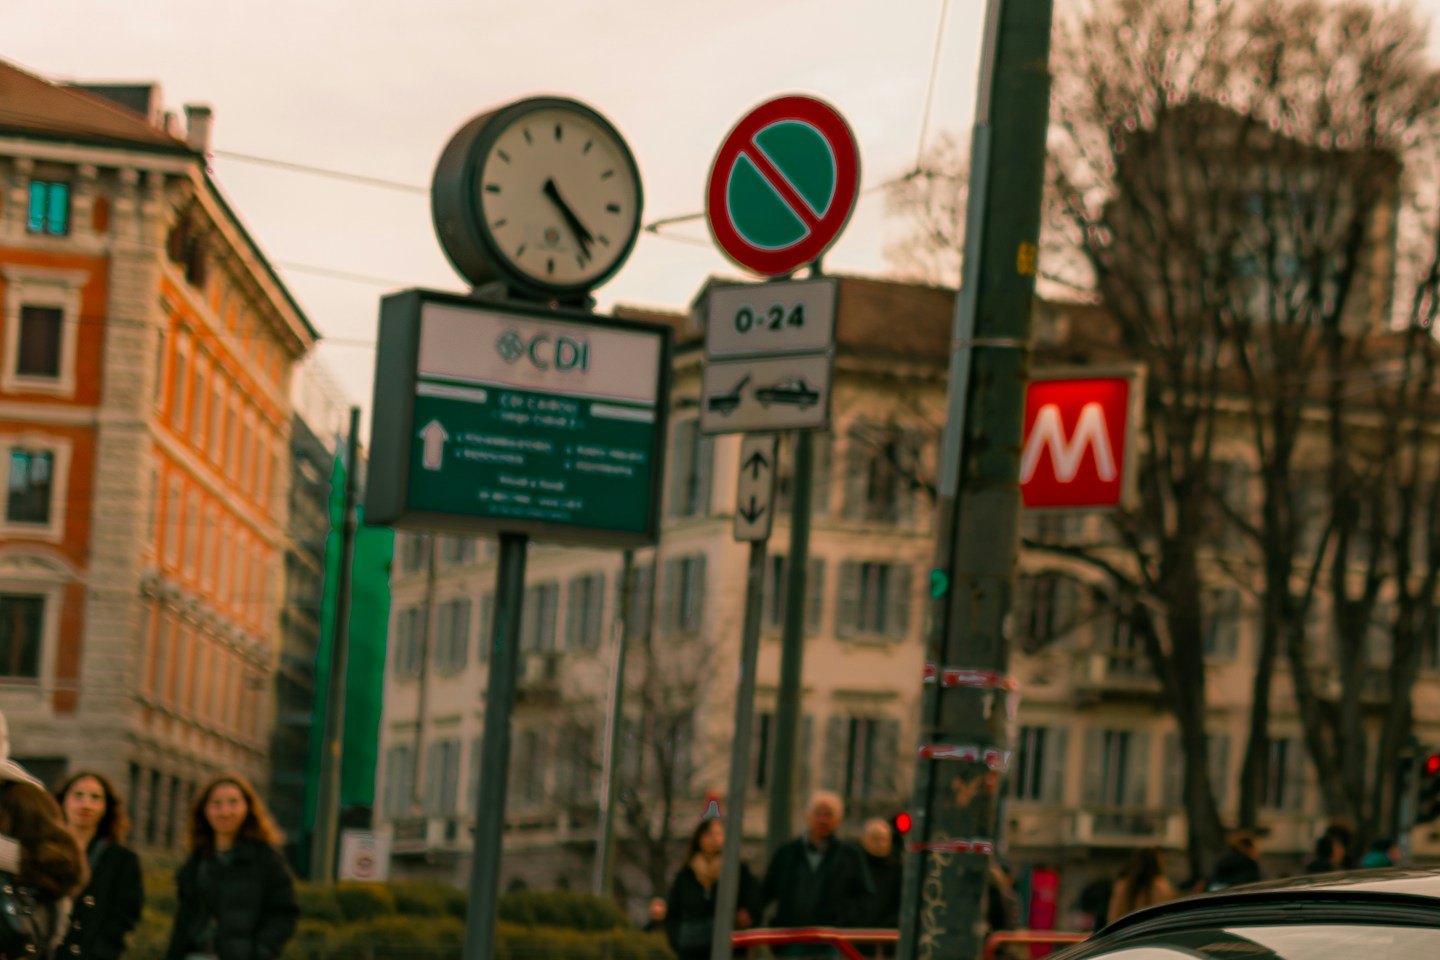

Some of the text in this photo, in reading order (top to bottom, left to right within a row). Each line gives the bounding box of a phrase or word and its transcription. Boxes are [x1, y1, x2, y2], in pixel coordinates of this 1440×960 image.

[735, 304, 805, 334] 0-24
[528, 334, 590, 372] CDI
[1019, 402, 1118, 484] M
